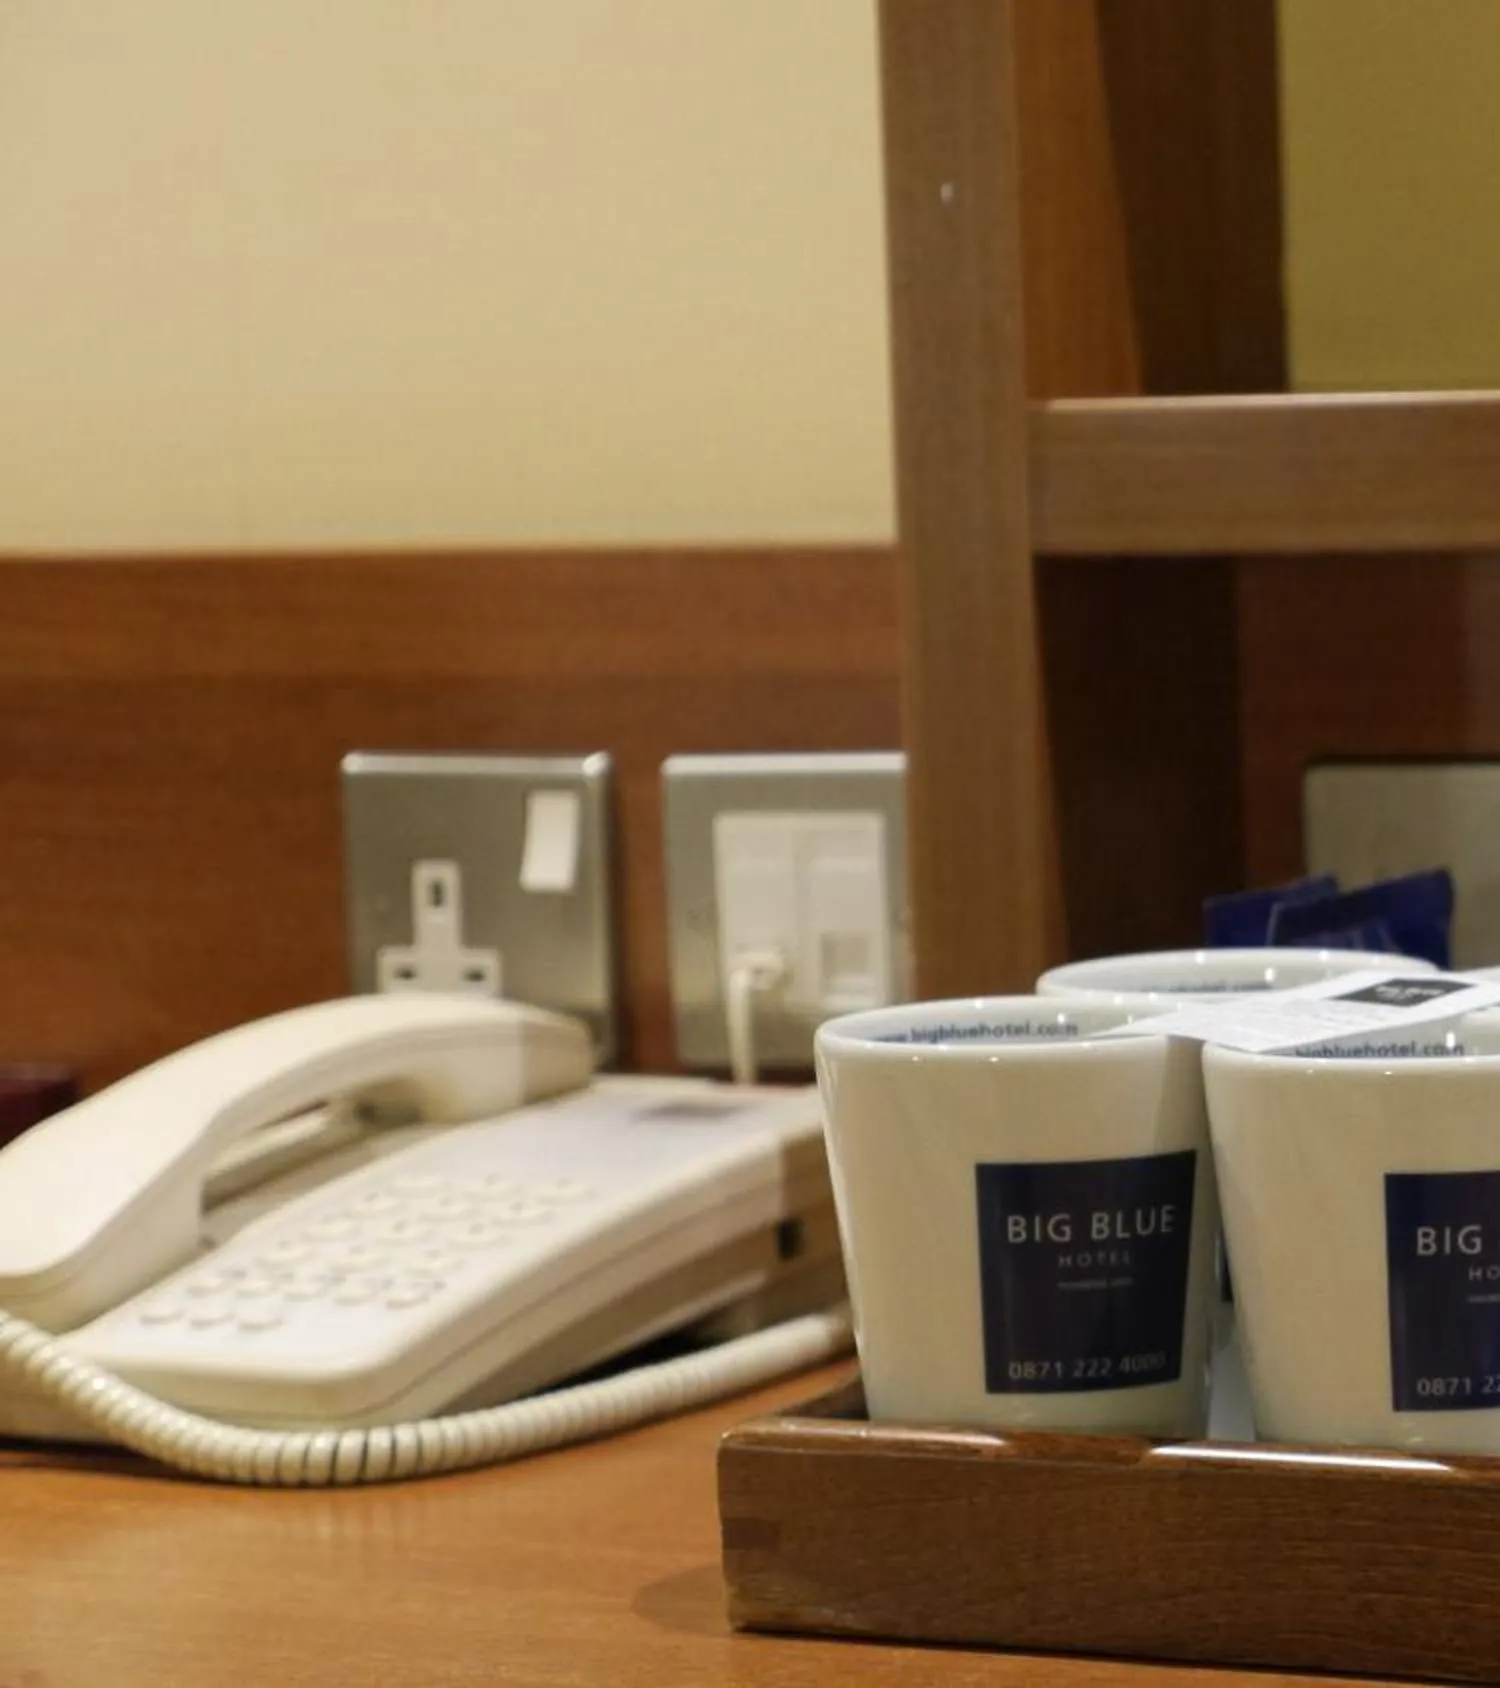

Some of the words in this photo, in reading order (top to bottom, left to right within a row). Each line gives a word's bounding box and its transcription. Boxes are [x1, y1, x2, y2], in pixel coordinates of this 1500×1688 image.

[1006, 1212, 1073, 1244] BIG
[1090, 1204, 1176, 1241] BLUE
[1416, 1224, 1483, 1257] BIG
[1058, 1250, 1132, 1269] HOTEL
[1008, 1360, 1064, 1381] 0871
[1072, 1356, 1113, 1379] 222
[1118, 1351, 1168, 1374] 4000
[1416, 1376, 1472, 1396] 0871
